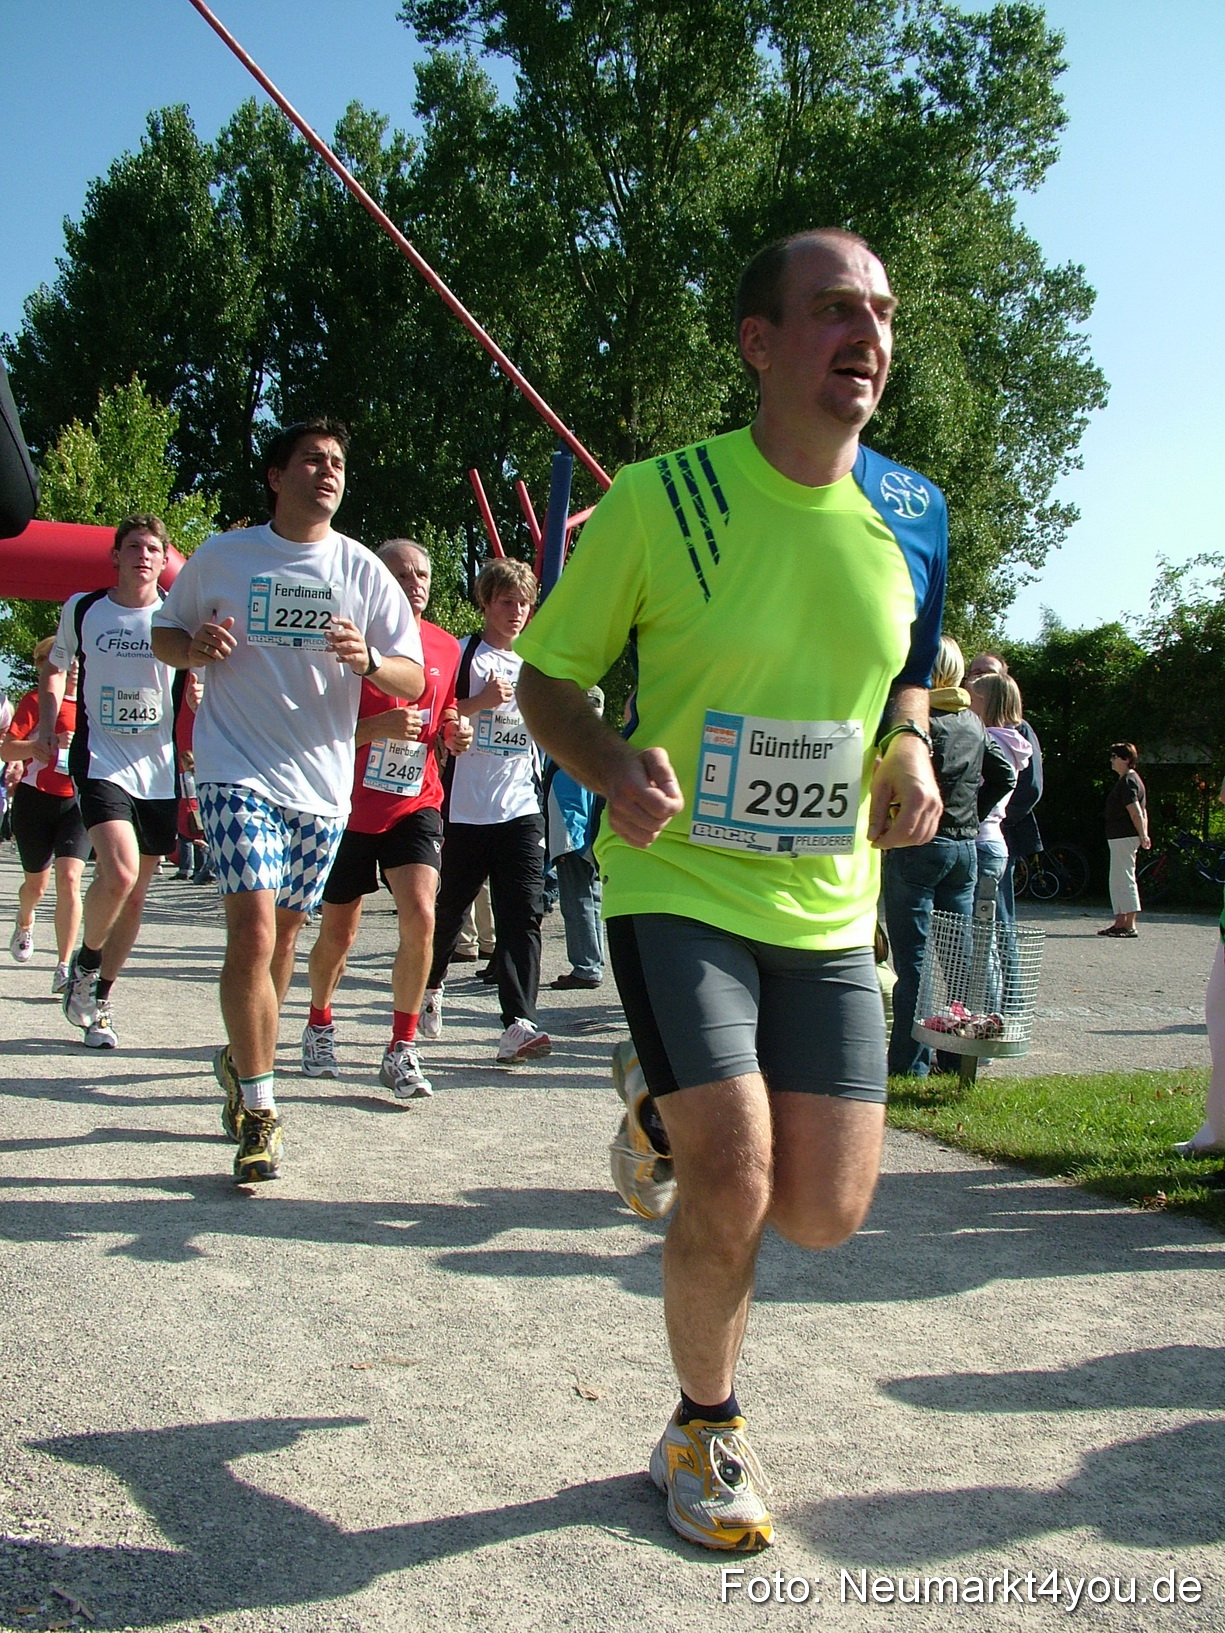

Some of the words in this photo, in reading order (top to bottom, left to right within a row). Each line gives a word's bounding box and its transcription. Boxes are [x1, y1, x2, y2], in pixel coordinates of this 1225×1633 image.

[275, 583, 332, 600] Ferdinand
[252, 602, 259, 612] C
[275, 608, 332, 630] 2222
[108, 638, 152, 650] Fisch
[117, 690, 140, 701] David
[103, 704, 108, 712] C
[119, 708, 157, 721] 2443
[495, 714, 520, 726] Michael
[480, 726, 486, 734] C
[494, 731, 527, 746] 2445
[750, 730, 833, 760] Günther
[389, 742, 420, 758] Herbert
[386, 762, 422, 781] 2487
[705, 764, 716, 782] C
[745, 780, 849, 819] 2925
[692, 823, 757, 843] BOCK
[795, 836, 853, 846] PFLEIDERER
